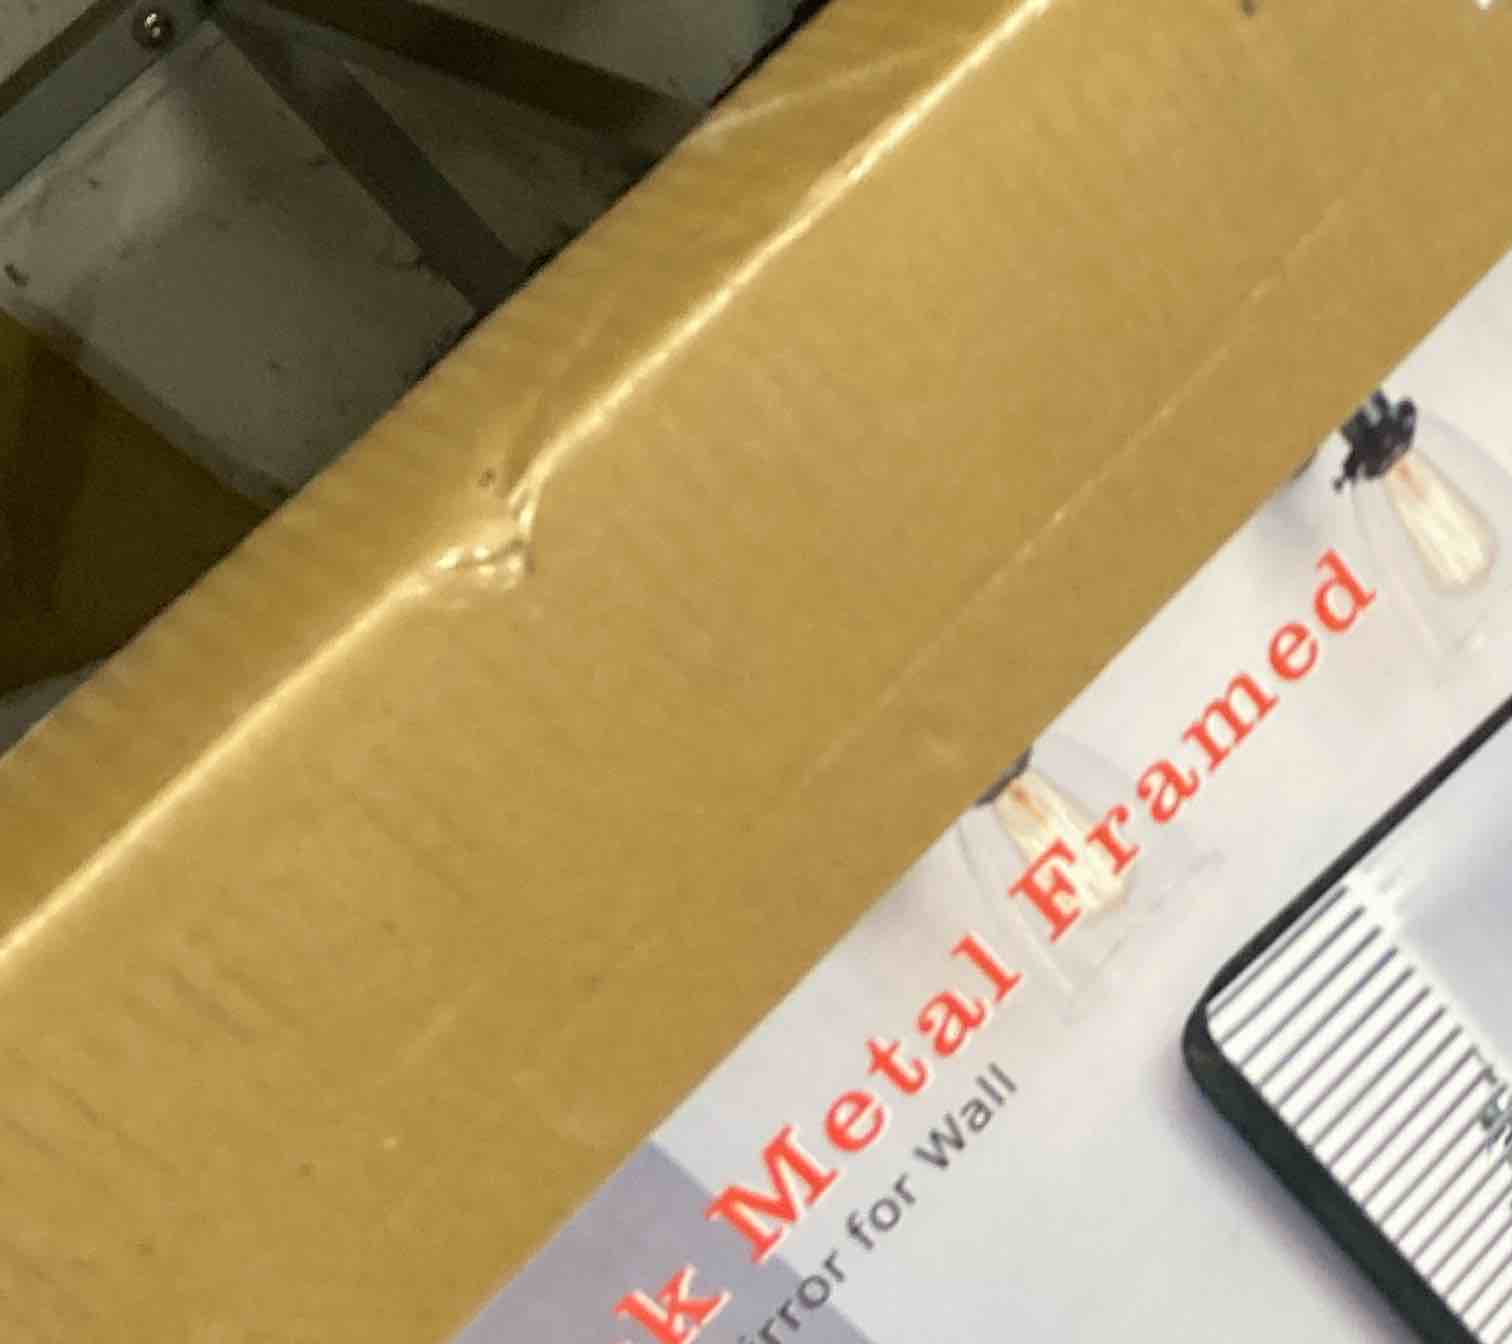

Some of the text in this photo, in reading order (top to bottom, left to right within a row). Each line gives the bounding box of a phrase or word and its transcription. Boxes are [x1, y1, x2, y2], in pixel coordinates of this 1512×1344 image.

[704, 935, 1021, 1263] Metal
[1008, 549, 1376, 943] Framed
[844, 1172, 917, 1252] for
[913, 1061, 1019, 1173] Wall
